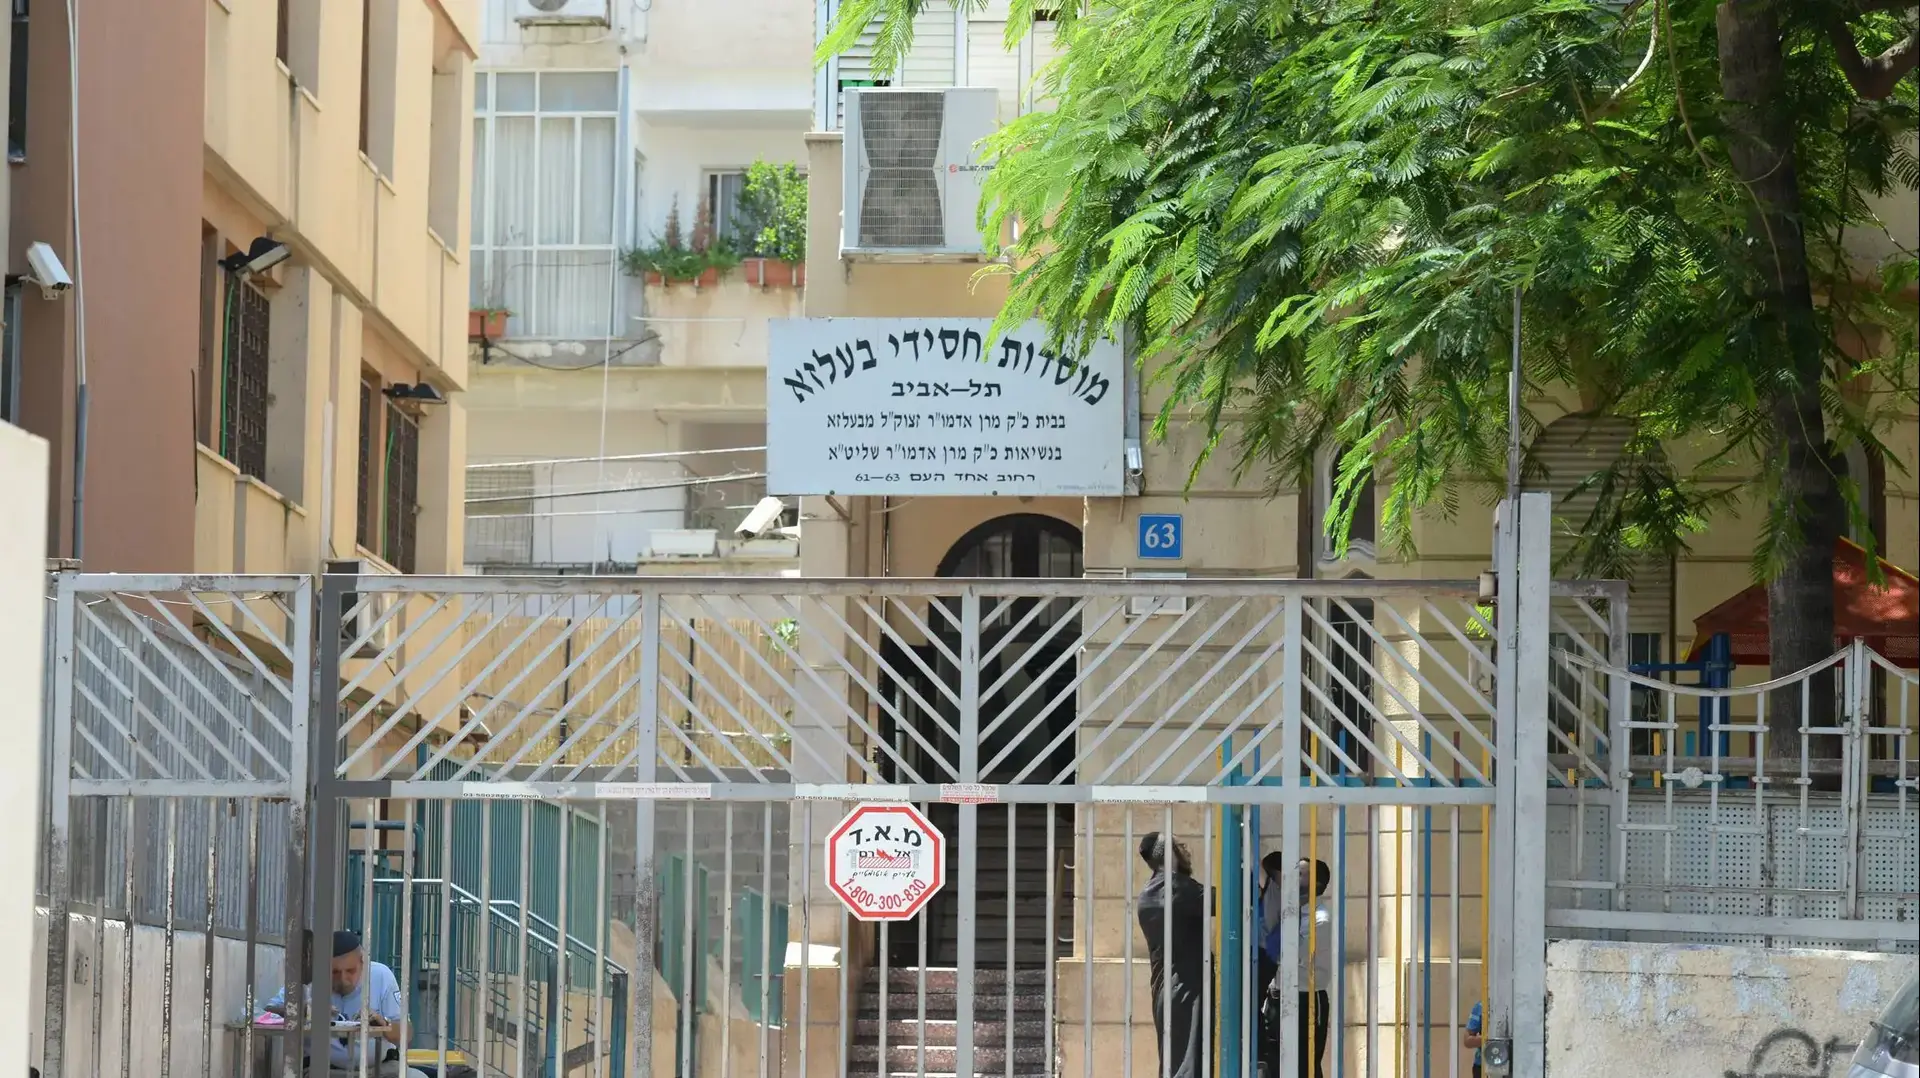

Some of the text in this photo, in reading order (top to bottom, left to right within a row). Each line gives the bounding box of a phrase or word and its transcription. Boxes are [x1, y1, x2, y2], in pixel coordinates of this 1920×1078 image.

[783, 327, 1110, 406] מוסדות חסידי בעלזא
[891, 379, 1002, 398] תל-אביב
[827, 411, 1066, 433] בבית כ"ק מרן אדמו"ר זצוק"ל מבעלזא
[829, 443, 1062, 464] בנשיאות כ"ק מרן אדמו"ר שליט"א
[855, 473, 1036, 482] רחוב אחד העם 61-63
[1145, 523, 1175, 548] 63
[849, 825, 922, 847] מ.א.ד
[859, 849, 911, 858] אל רם
[842, 878, 926, 910] 1-800-300-830
